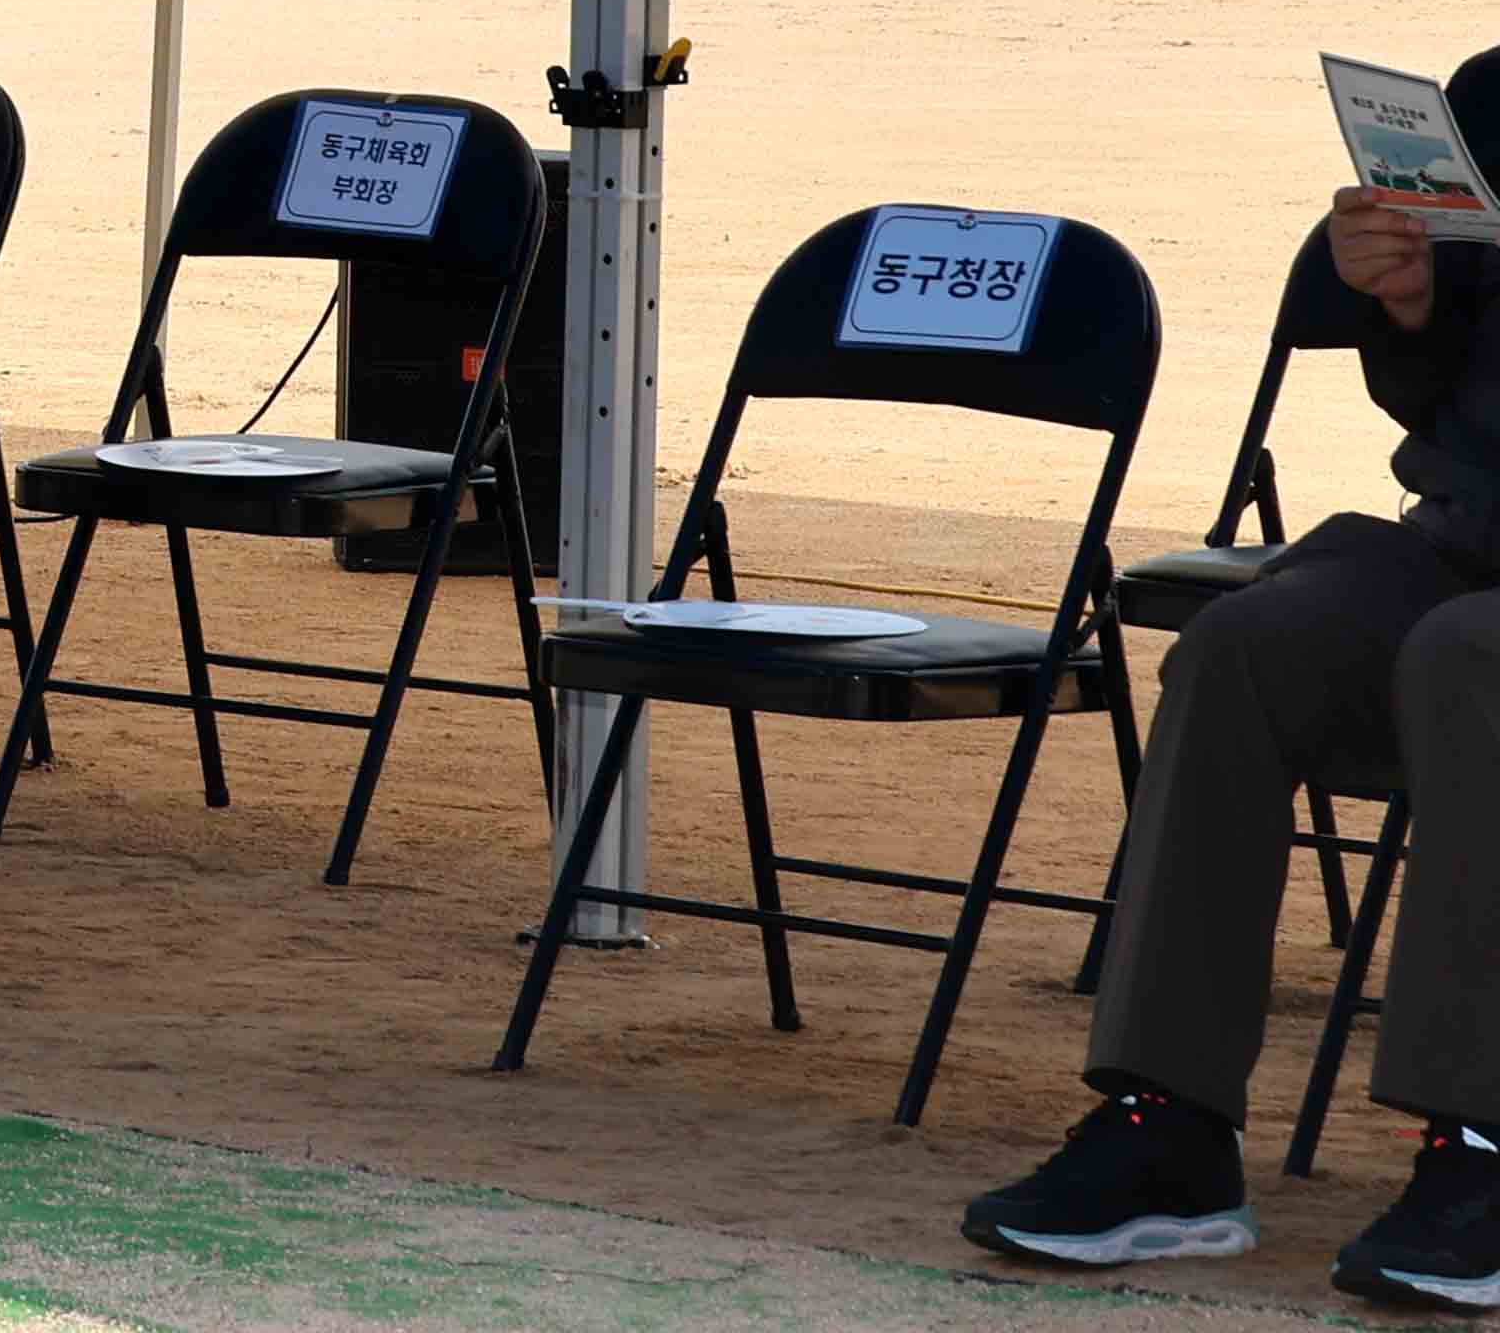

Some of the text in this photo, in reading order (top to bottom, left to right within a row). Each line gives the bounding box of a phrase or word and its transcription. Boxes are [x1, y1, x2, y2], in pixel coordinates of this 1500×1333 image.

[321, 132, 432, 168] 동구체육회
[332, 174, 399, 206] 부회장
[872, 252, 1027, 302] 동구청장
